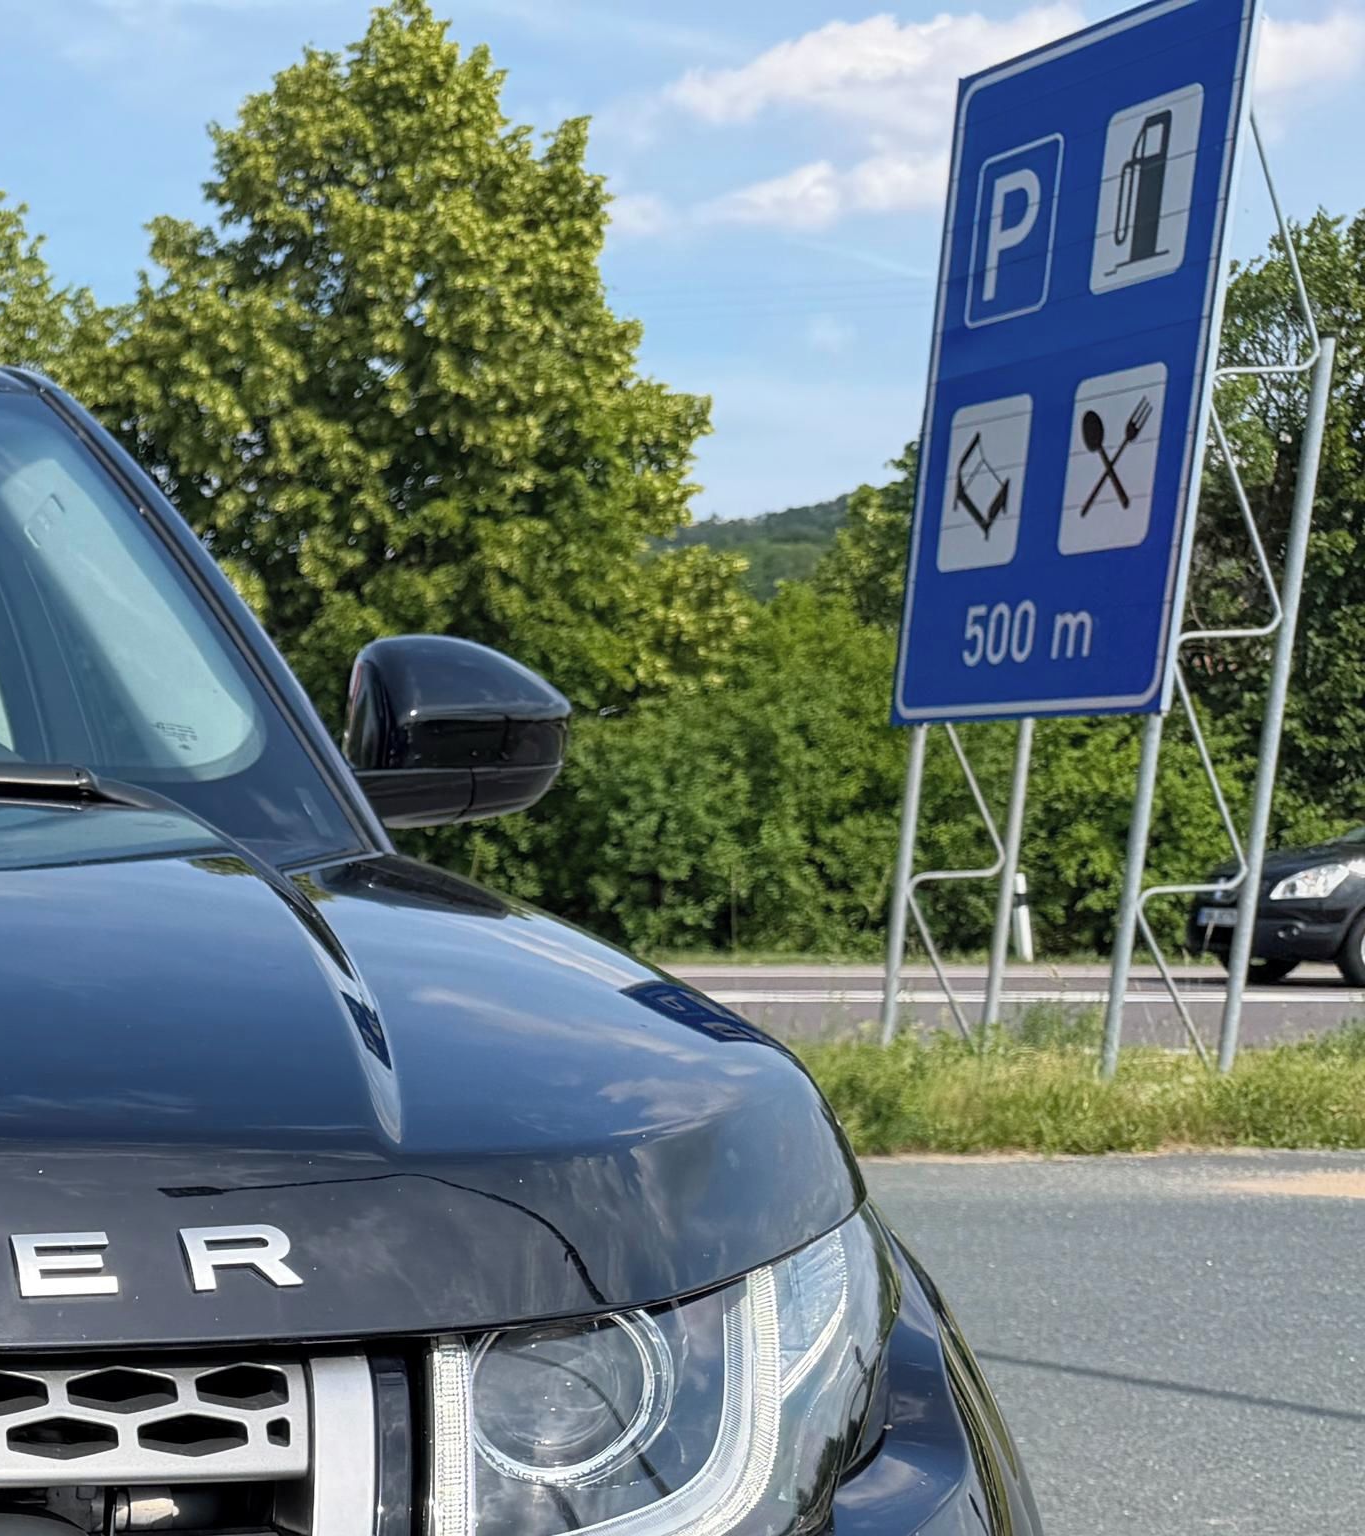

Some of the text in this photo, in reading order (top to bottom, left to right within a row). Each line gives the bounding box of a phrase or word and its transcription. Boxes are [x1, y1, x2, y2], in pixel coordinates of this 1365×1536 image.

[982, 169, 1041, 302] P
[962, 600, 1093, 667] 500 m
